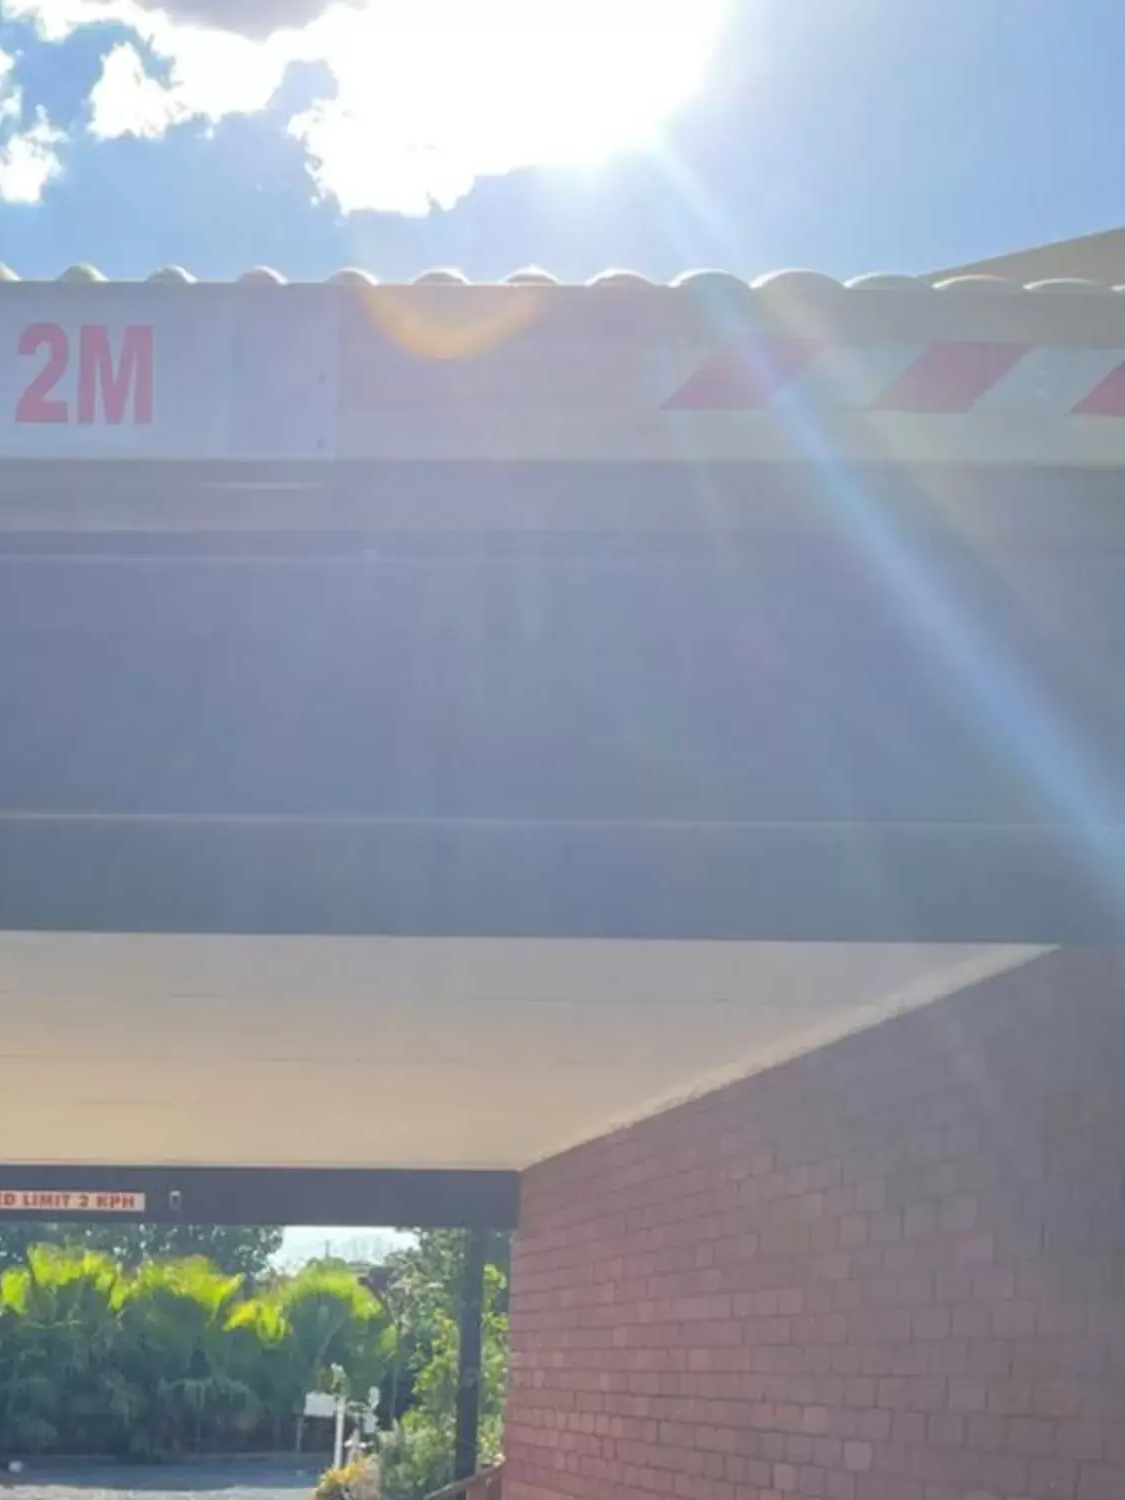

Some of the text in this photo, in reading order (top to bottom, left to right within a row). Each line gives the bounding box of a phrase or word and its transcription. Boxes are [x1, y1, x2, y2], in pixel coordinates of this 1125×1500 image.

[15, 322, 156, 425] 2M
[24, 1192, 70, 1207] LIMIT
[96, 1193, 135, 1208] KPH
